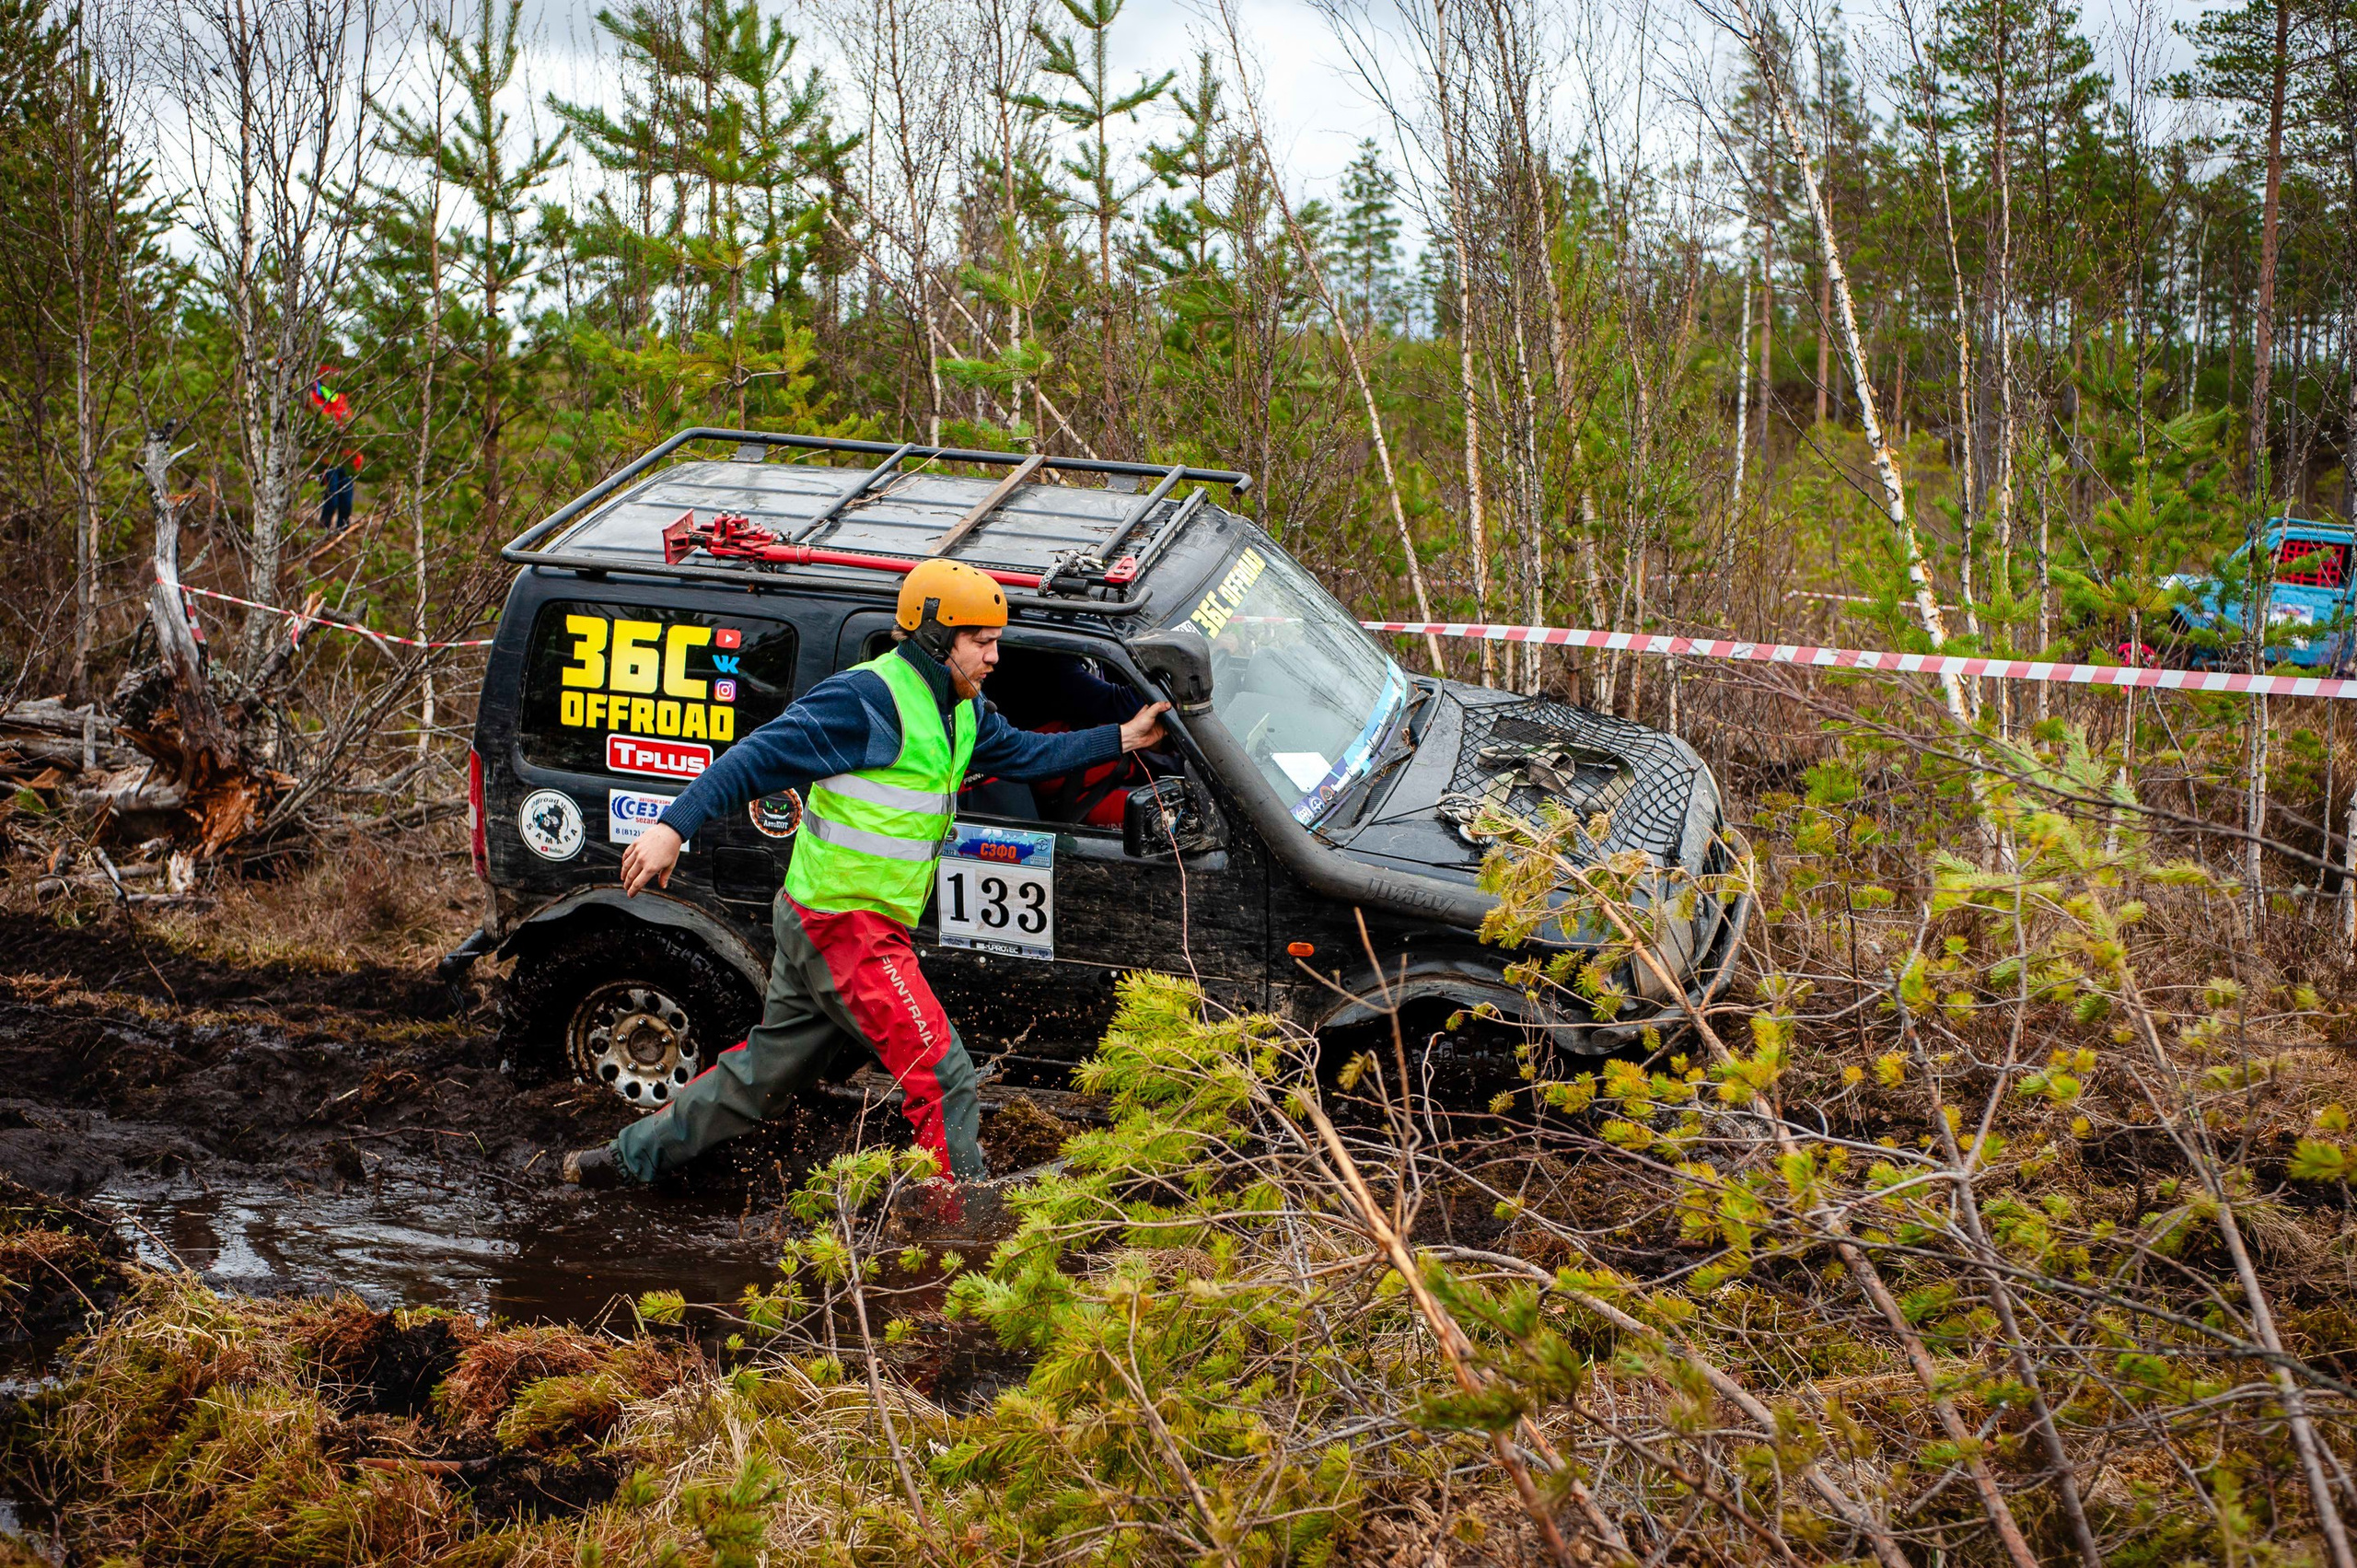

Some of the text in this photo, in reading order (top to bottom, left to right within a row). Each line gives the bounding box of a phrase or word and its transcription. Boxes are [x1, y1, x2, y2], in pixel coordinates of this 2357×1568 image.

[1216, 546, 1267, 608] OFFROAD
[560, 690, 735, 742] OFFROAD
[963, 772, 984, 785] FINN
[625, 799, 671, 819] СЕЗ
[526, 822, 578, 845] SAMARA
[615, 827, 621, 835] 8
[621, 828, 641, 837] (812)
[980, 842, 1017, 860] СЗФО
[946, 872, 1048, 934] 133
